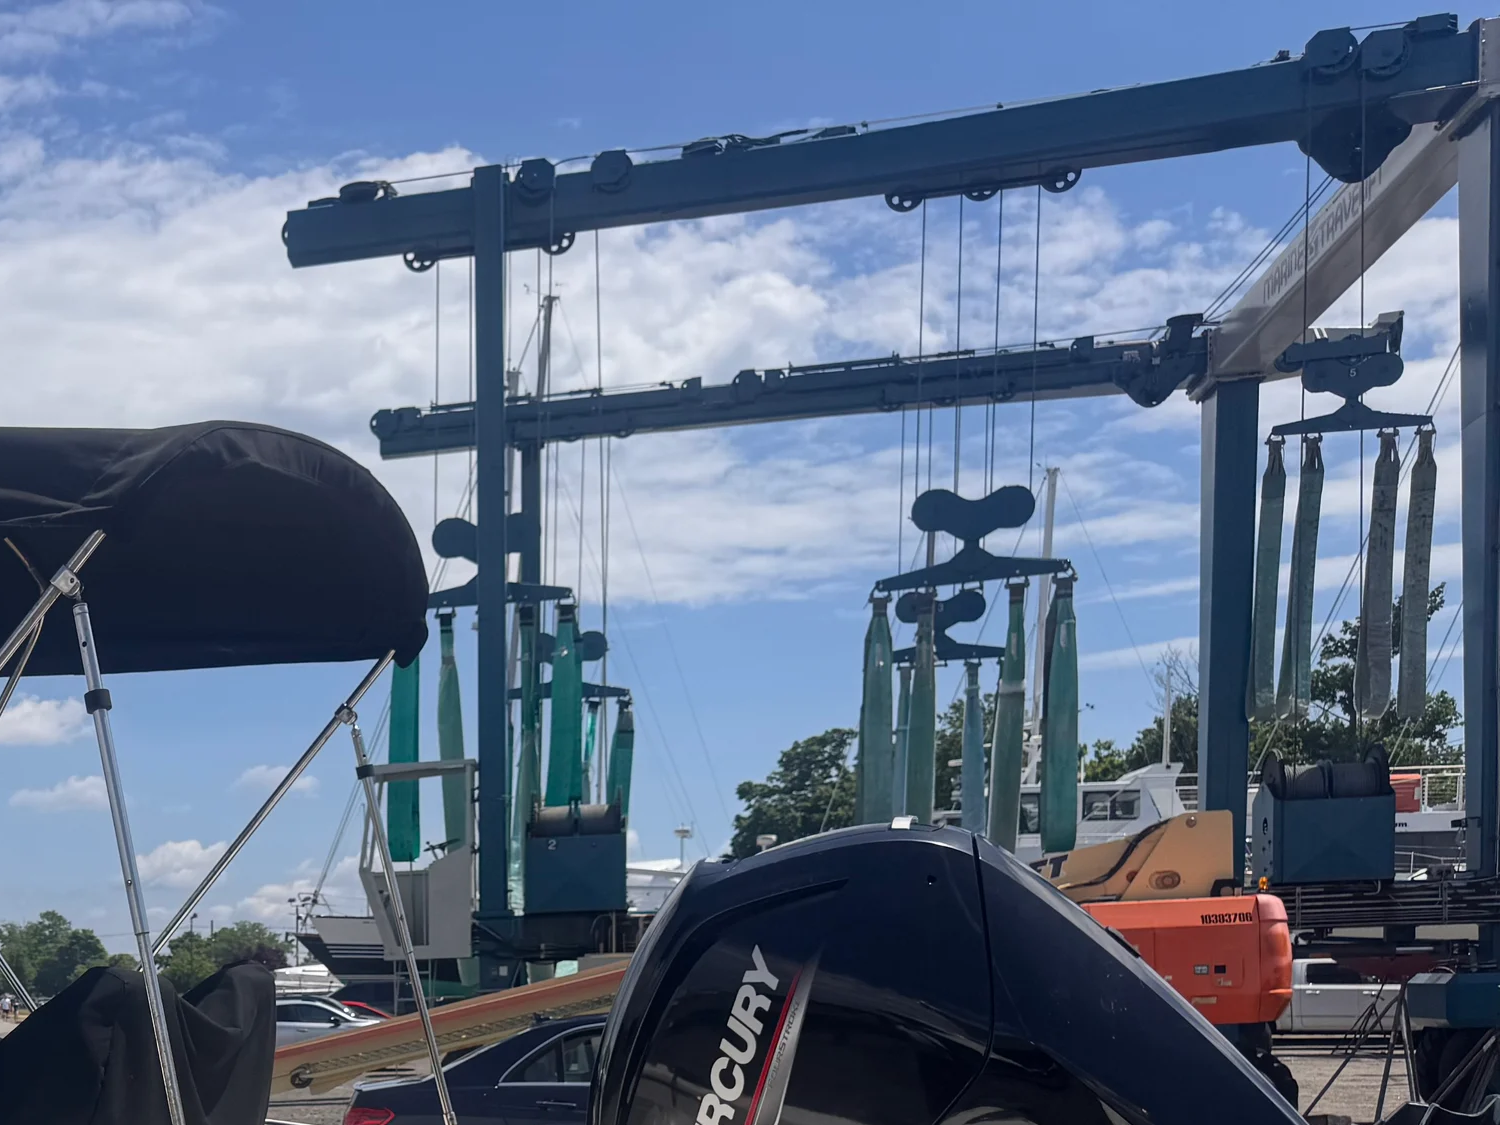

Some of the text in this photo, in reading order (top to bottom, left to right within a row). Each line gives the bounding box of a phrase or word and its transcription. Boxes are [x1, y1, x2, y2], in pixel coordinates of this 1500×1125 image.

[1263, 243, 1305, 304] MARINE
[1349, 367, 1357, 377] 5
[547, 839, 557, 850] 2
[767, 1000, 800, 1089] FOURSTROKE
